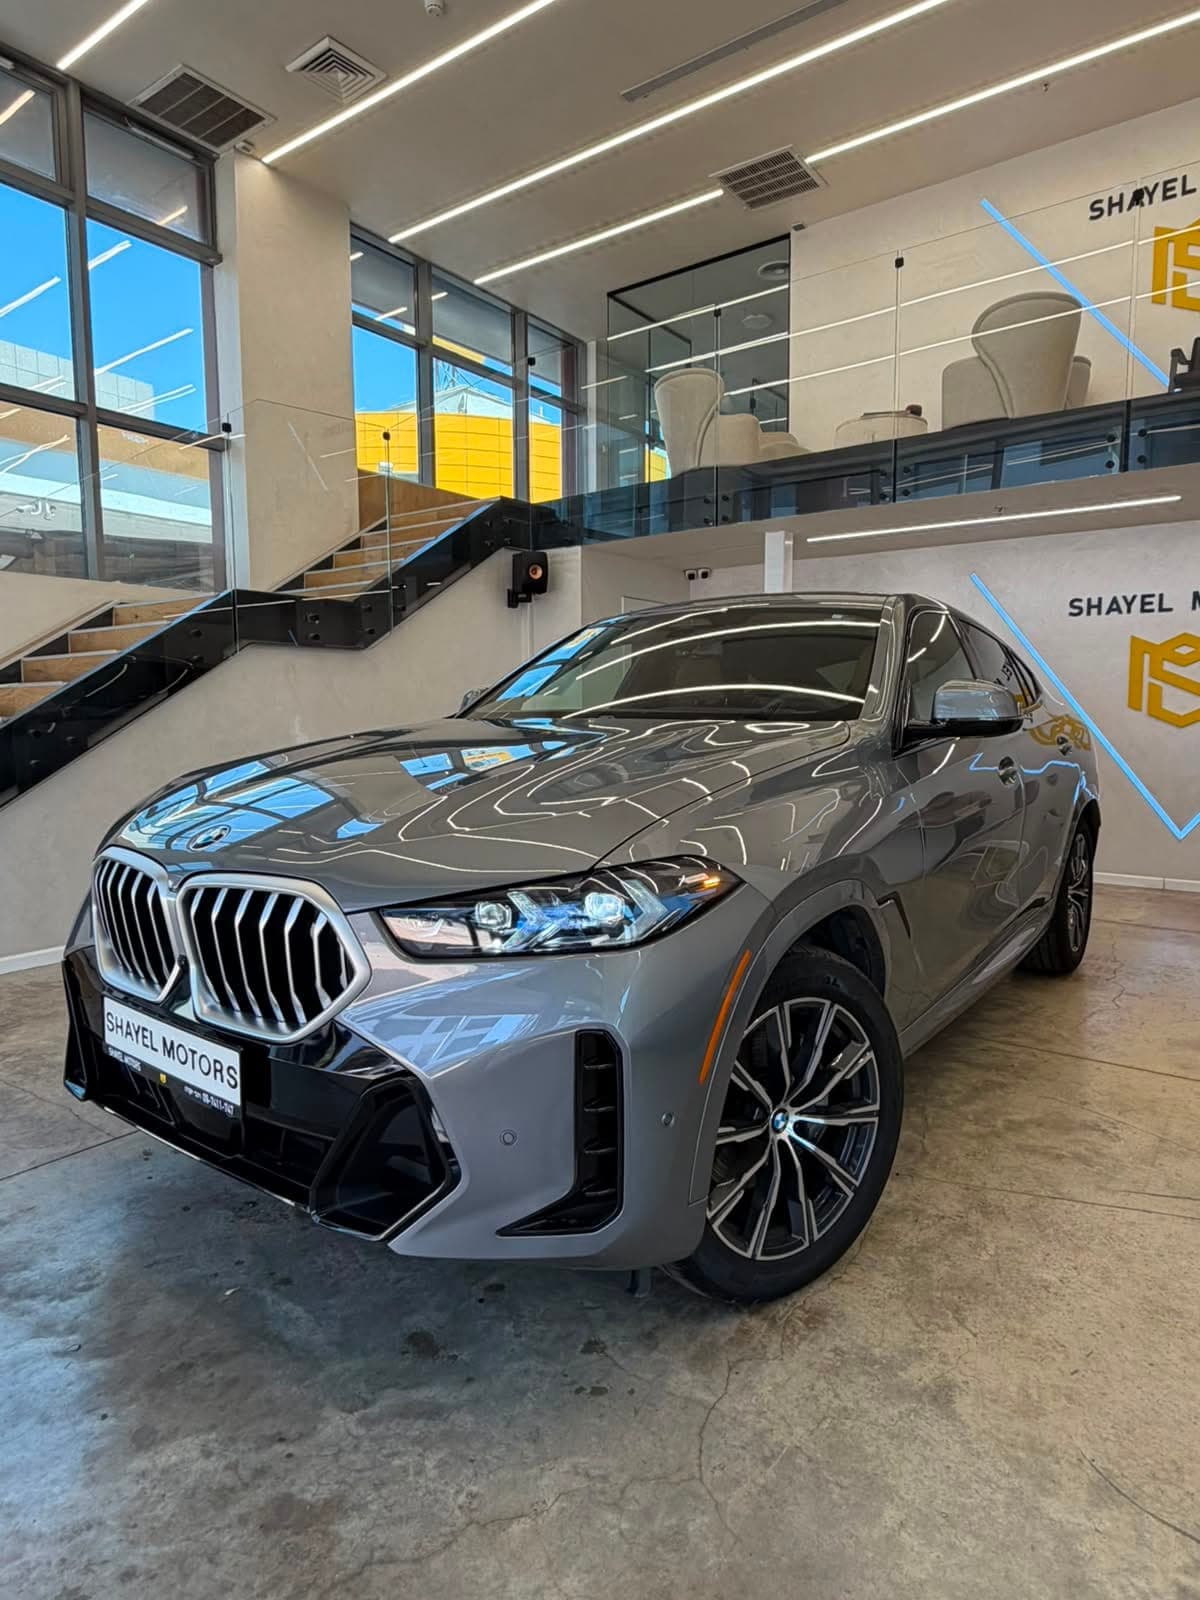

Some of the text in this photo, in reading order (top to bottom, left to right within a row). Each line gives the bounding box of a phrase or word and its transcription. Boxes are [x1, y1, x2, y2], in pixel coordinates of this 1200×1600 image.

[1068, 592, 1174, 617] SHAYEL
[106, 1011, 159, 1053] SHAYEL
[162, 1036, 238, 1089] MOTORS
